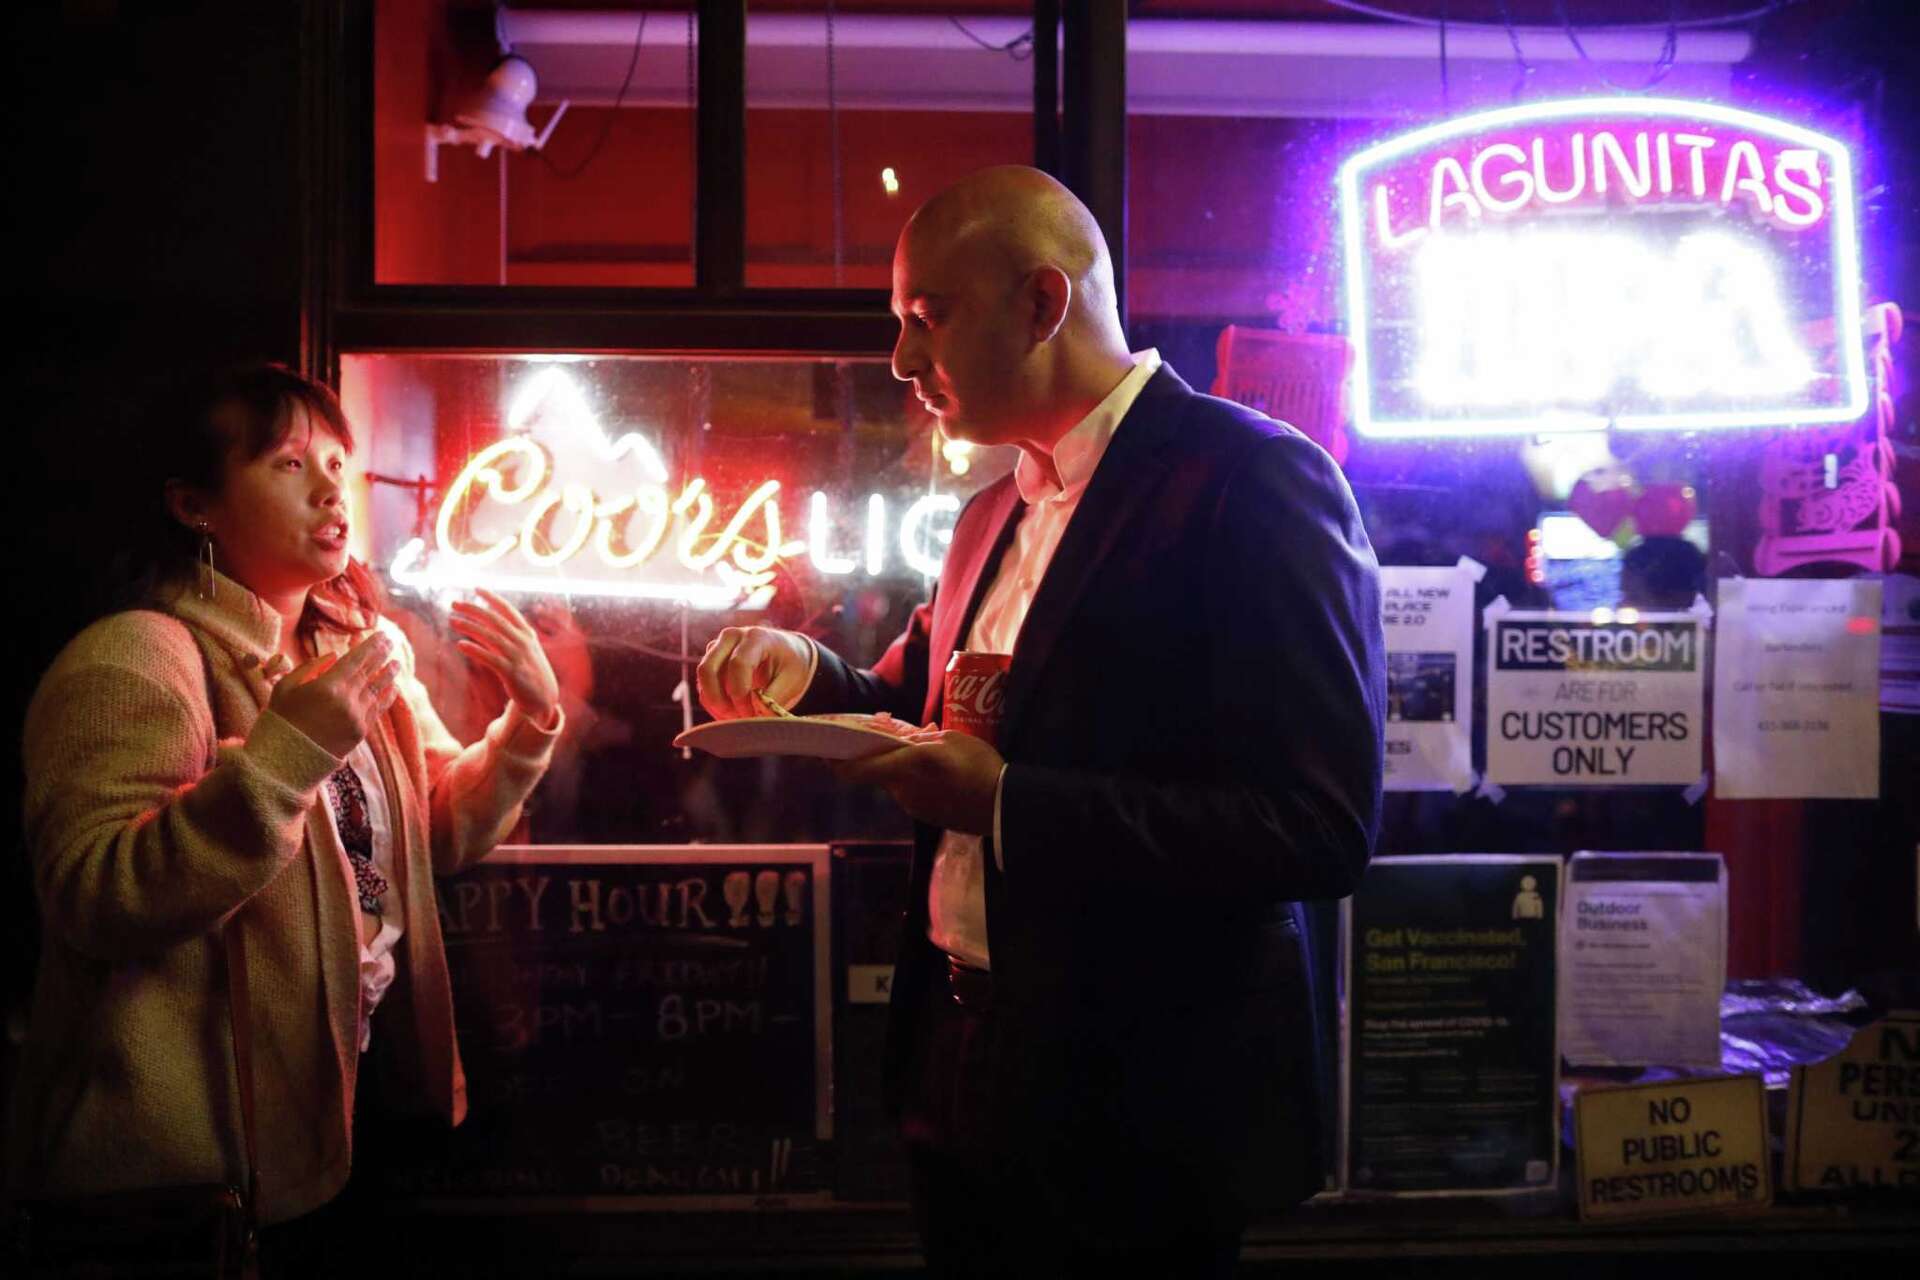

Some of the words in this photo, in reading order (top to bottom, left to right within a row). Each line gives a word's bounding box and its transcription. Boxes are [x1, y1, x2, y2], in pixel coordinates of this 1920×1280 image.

[1373, 131, 1824, 247] LAGUNITAS
[434, 437, 784, 572] Coors
[1417, 587, 1451, 599] NEW
[1501, 628, 1690, 664] RESTROOM
[1554, 683, 1595, 702] ARE
[1599, 682, 1638, 702] FOR
[1501, 711, 1689, 741] CUSTOMERS
[1552, 747, 1635, 775] ONLY
[1576, 901, 1642, 915] Outdoor
[1364, 929, 1403, 947] Get
[1576, 917, 1648, 931] Business
[1365, 952, 1405, 972] San
[1409, 951, 1517, 970] Francisco!
[1648, 1096, 1692, 1125] NO
[1621, 1129, 1722, 1166] PUBLIC
[1590, 1163, 1759, 1204] RESTROOMS
